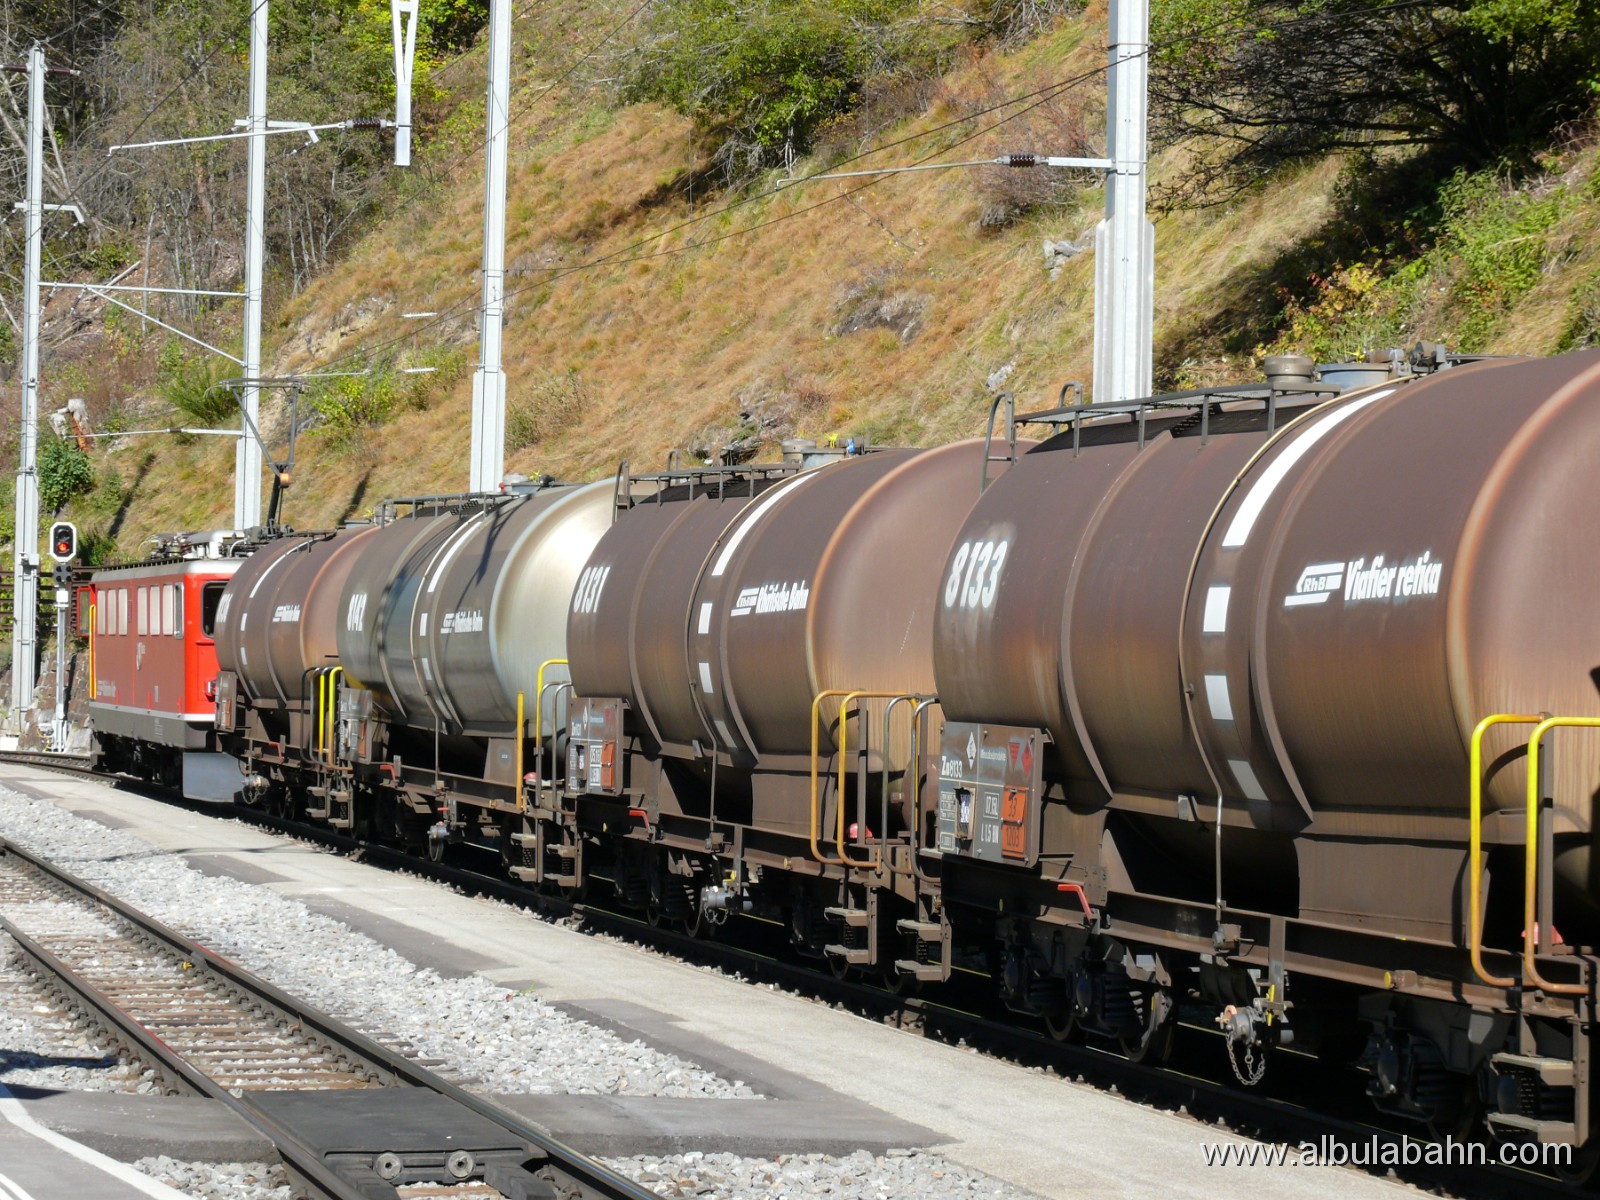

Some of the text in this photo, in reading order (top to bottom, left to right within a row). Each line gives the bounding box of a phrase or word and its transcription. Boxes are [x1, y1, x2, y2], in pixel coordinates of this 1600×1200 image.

[573, 566, 611, 613] 8131
[944, 541, 1007, 608] 8133
[1304, 550, 1443, 601] RhB Viafier retica
